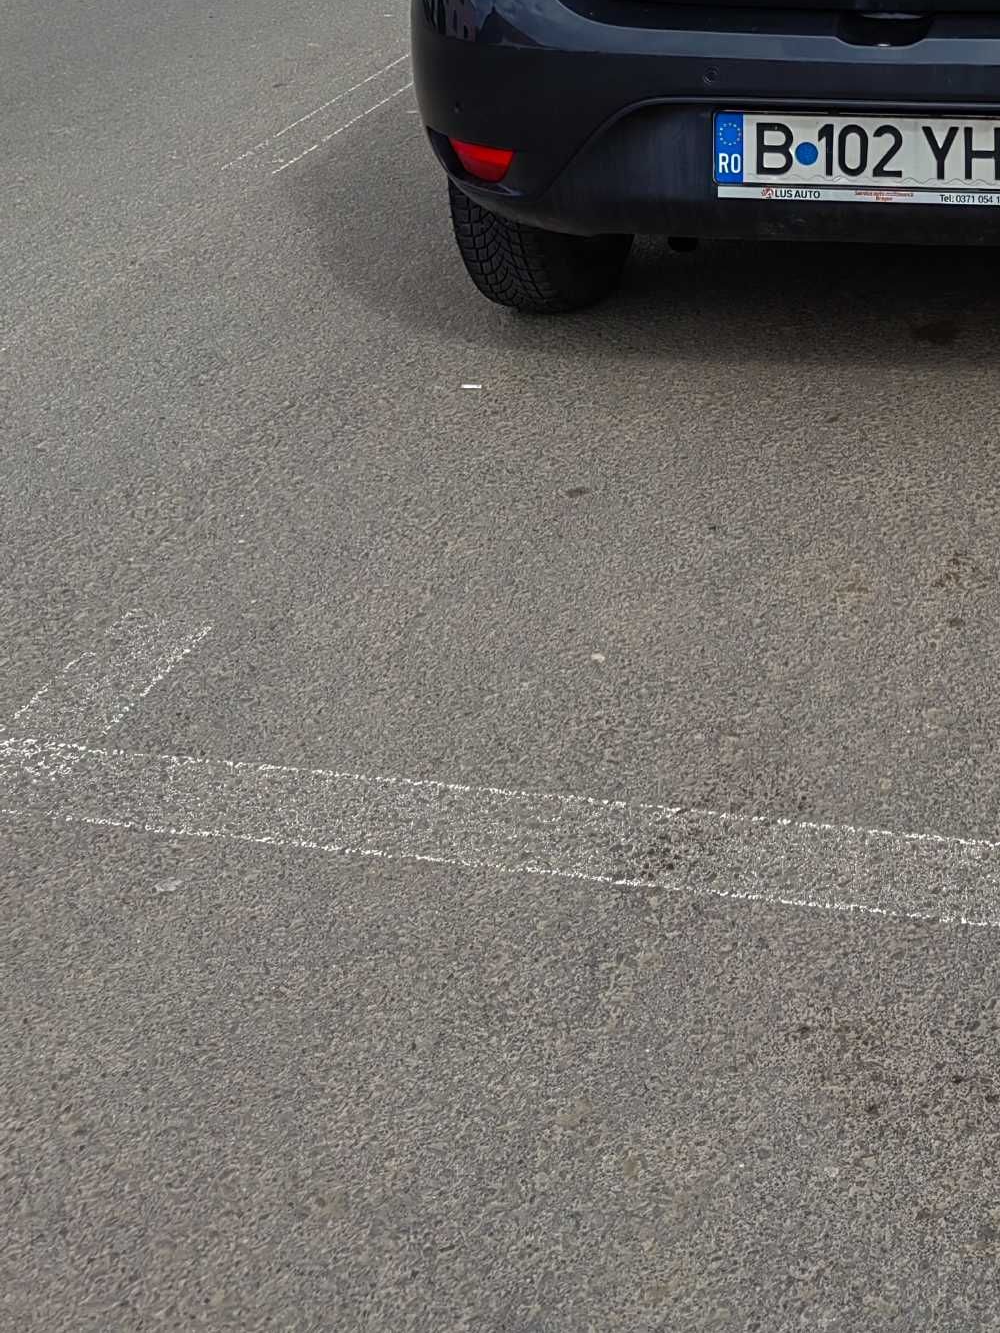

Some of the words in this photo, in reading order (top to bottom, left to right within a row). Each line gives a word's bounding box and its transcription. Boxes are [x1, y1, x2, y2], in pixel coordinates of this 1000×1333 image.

[756, 123, 794, 176] B
[818, 123, 903, 178] 102
[719, 153, 741, 174] RO
[794, 190, 821, 199] AUTO
[956, 195, 975, 203] 0371
[978, 195, 993, 204] 054
